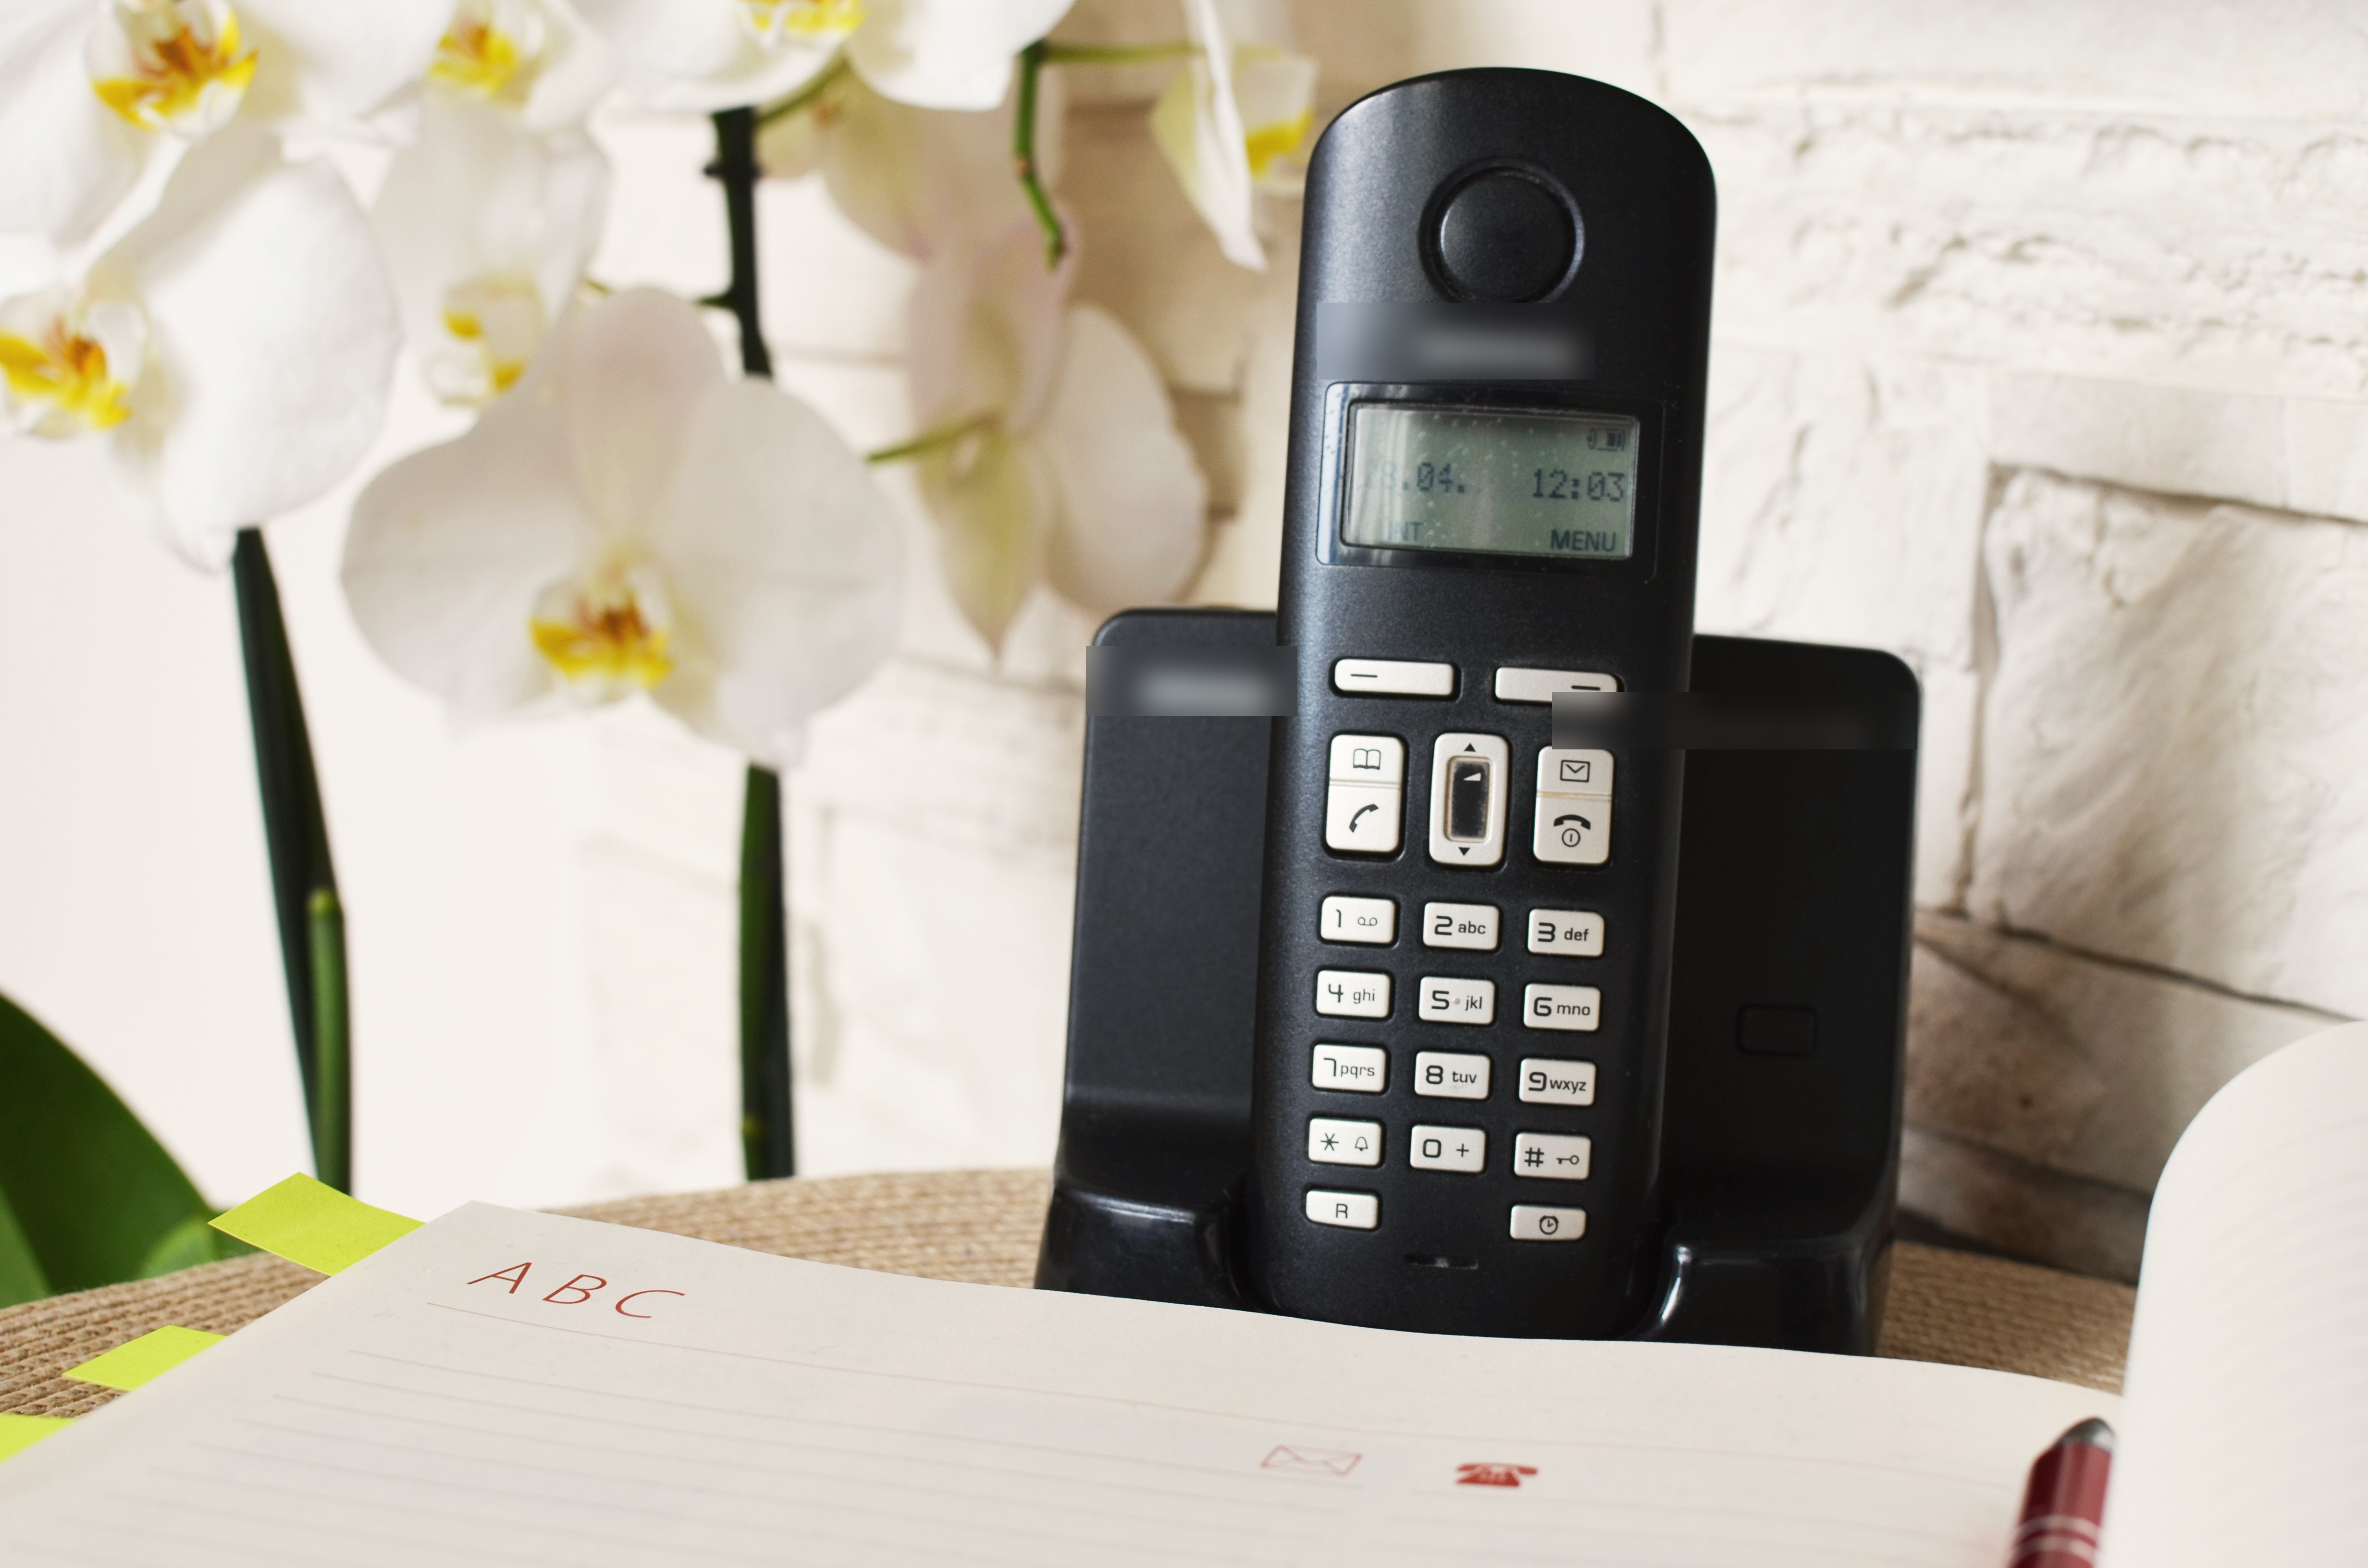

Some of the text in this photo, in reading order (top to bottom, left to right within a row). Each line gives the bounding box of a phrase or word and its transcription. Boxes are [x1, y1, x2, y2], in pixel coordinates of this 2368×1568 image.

[1532, 468, 1625, 502] 12:03
[1550, 529, 1617, 552] MENU
[1335, 908, 1342, 929] 1
[1433, 915, 1487, 936] 2 abc
[1537, 921, 1590, 943] 3 def
[1327, 983, 1376, 1005] 4 ghi
[1431, 990, 1483, 1012] 5 jkl
[1533, 996, 1591, 1017] 6 mno
[1322, 1057, 1376, 1080] 7 pqrs
[1425, 1064, 1478, 1085] 8 tuv
[1528, 1071, 1588, 1095] 9 wxyz
[1335, 1202, 1349, 1220] R
